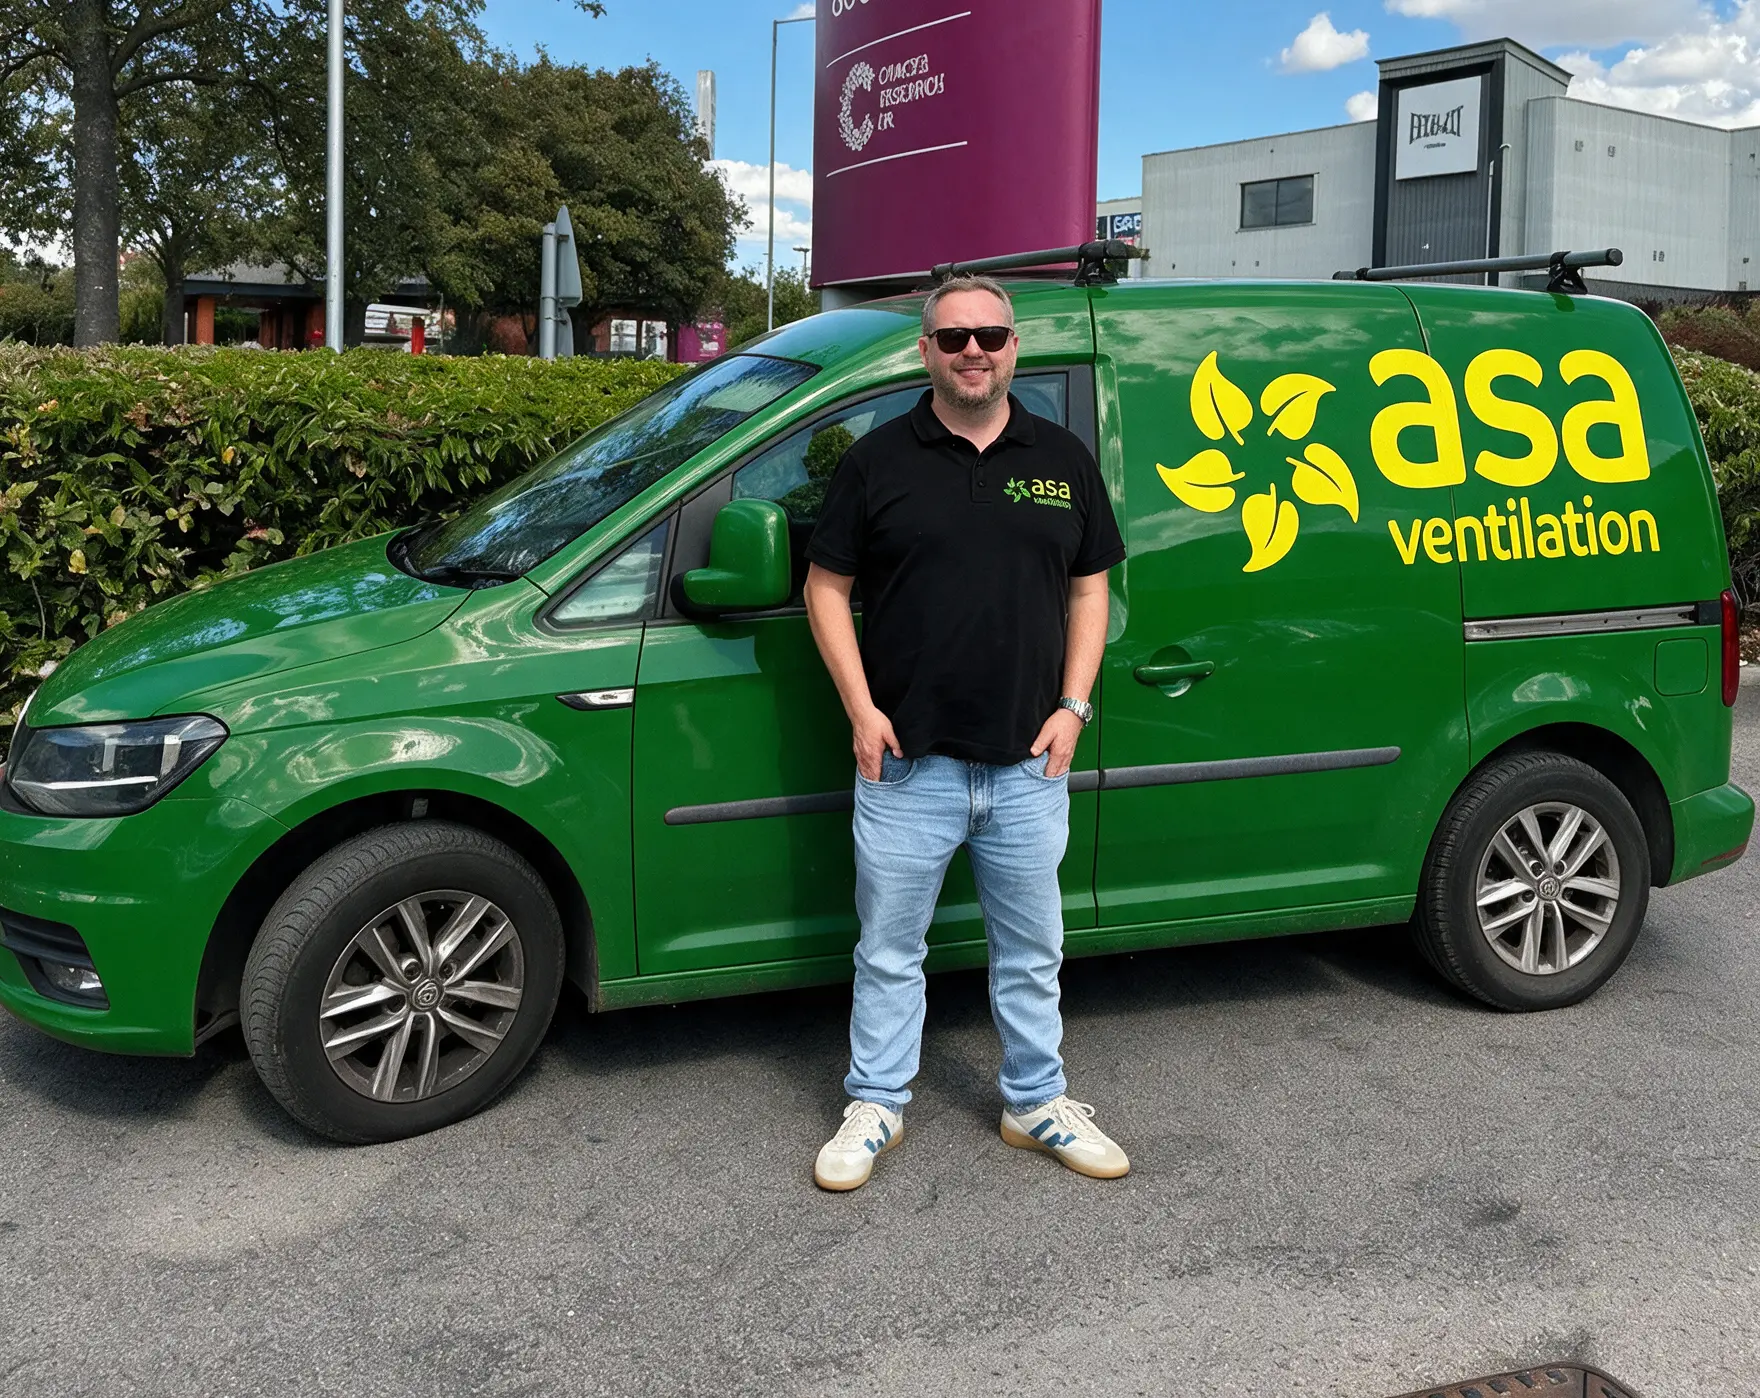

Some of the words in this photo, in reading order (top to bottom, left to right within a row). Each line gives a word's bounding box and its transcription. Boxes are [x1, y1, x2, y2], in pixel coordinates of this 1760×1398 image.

[1368, 348, 1651, 489] asa
[1031, 478, 1071, 500] asa
[1387, 494, 1661, 565] ventilation
